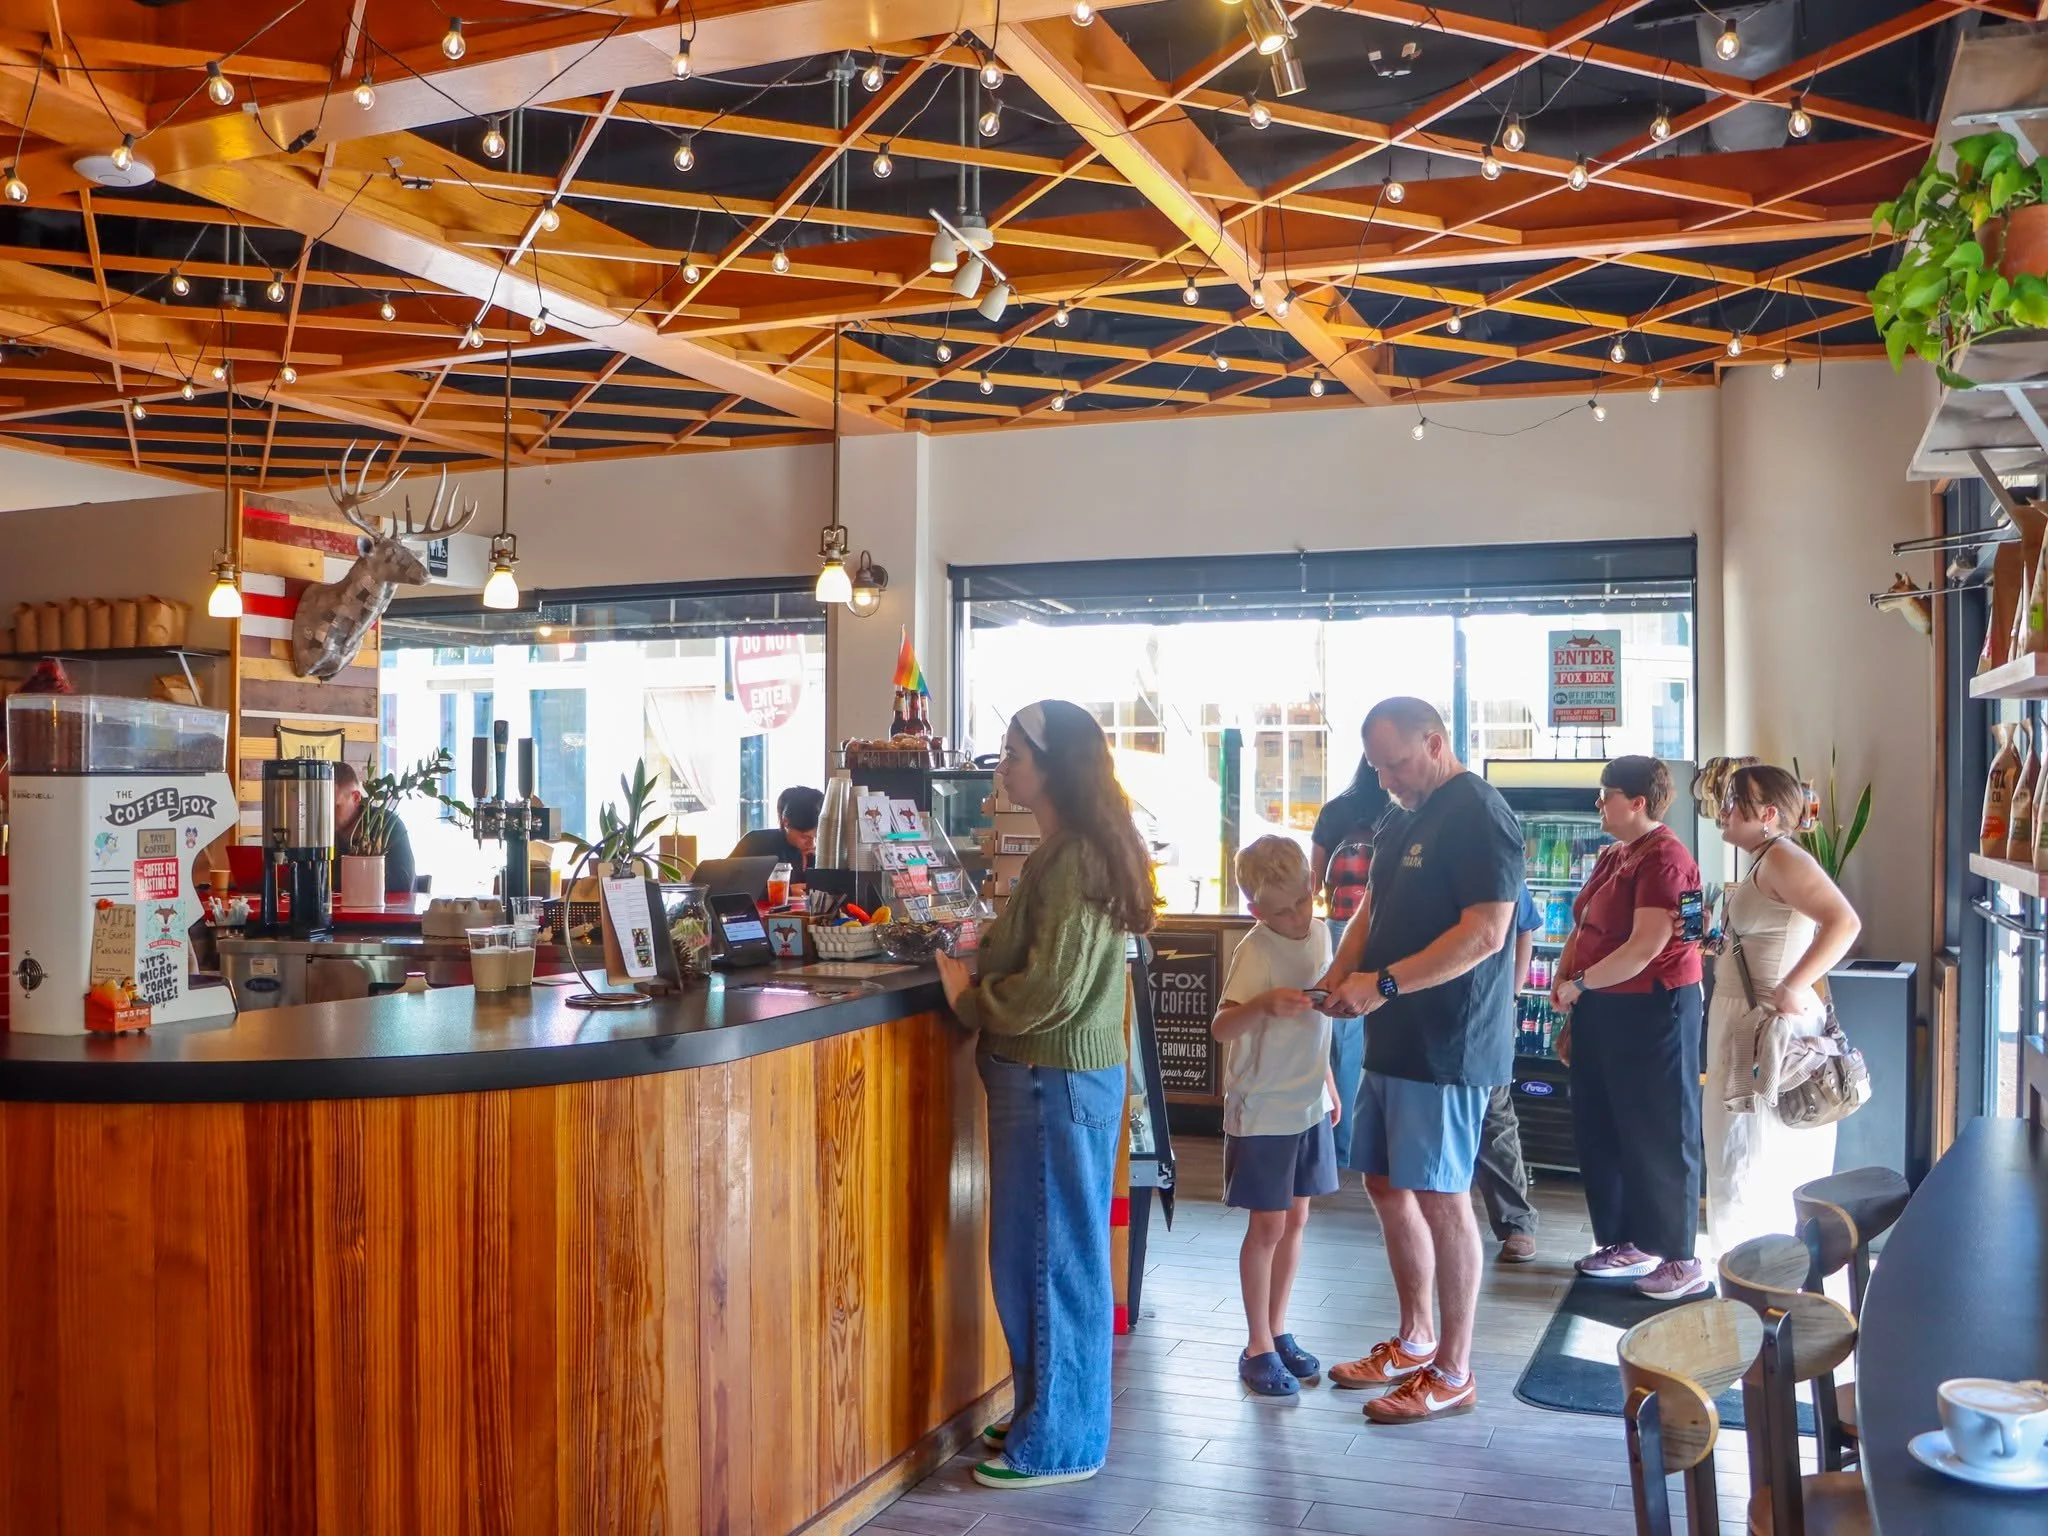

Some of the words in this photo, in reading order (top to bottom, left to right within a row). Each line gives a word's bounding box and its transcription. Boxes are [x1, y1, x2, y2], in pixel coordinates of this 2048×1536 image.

[742, 635, 761, 655] DO
[765, 634, 793, 652] NOT
[1553, 650, 1615, 666] ENTER
[1560, 672, 1582, 684] FOX
[1585, 672, 1609, 684] DEN
[750, 684, 792, 709] ENTER
[1568, 691, 1580, 699] OFF
[1581, 691, 1599, 699] FIRST
[1600, 691, 1616, 699] TIME
[300, 744, 325, 760] DON'T
[116, 790, 133, 799] THE
[114, 790, 176, 824] COFFEE
[181, 798, 210, 815] FOX
[143, 862, 165, 877] COFFEE
[165, 861, 177, 876] FOX
[168, 875, 177, 890] CO.
[145, 952, 166, 969] IT'S
[140, 963, 178, 984] MICRO-
[1162, 973, 1207, 990] FOX
[145, 976, 178, 995] FOAM-
[147, 986, 179, 1006] ABLE!
[1160, 990, 1208, 1015] COFFEE
[1170, 1026, 1180, 1034] FOR
[1180, 1026, 1189, 1034] 24
[1162, 1042, 1207, 1059] GROWLERS
[1160, 1068, 1183, 1081] your
[1183, 1068, 1206, 1082] day!
